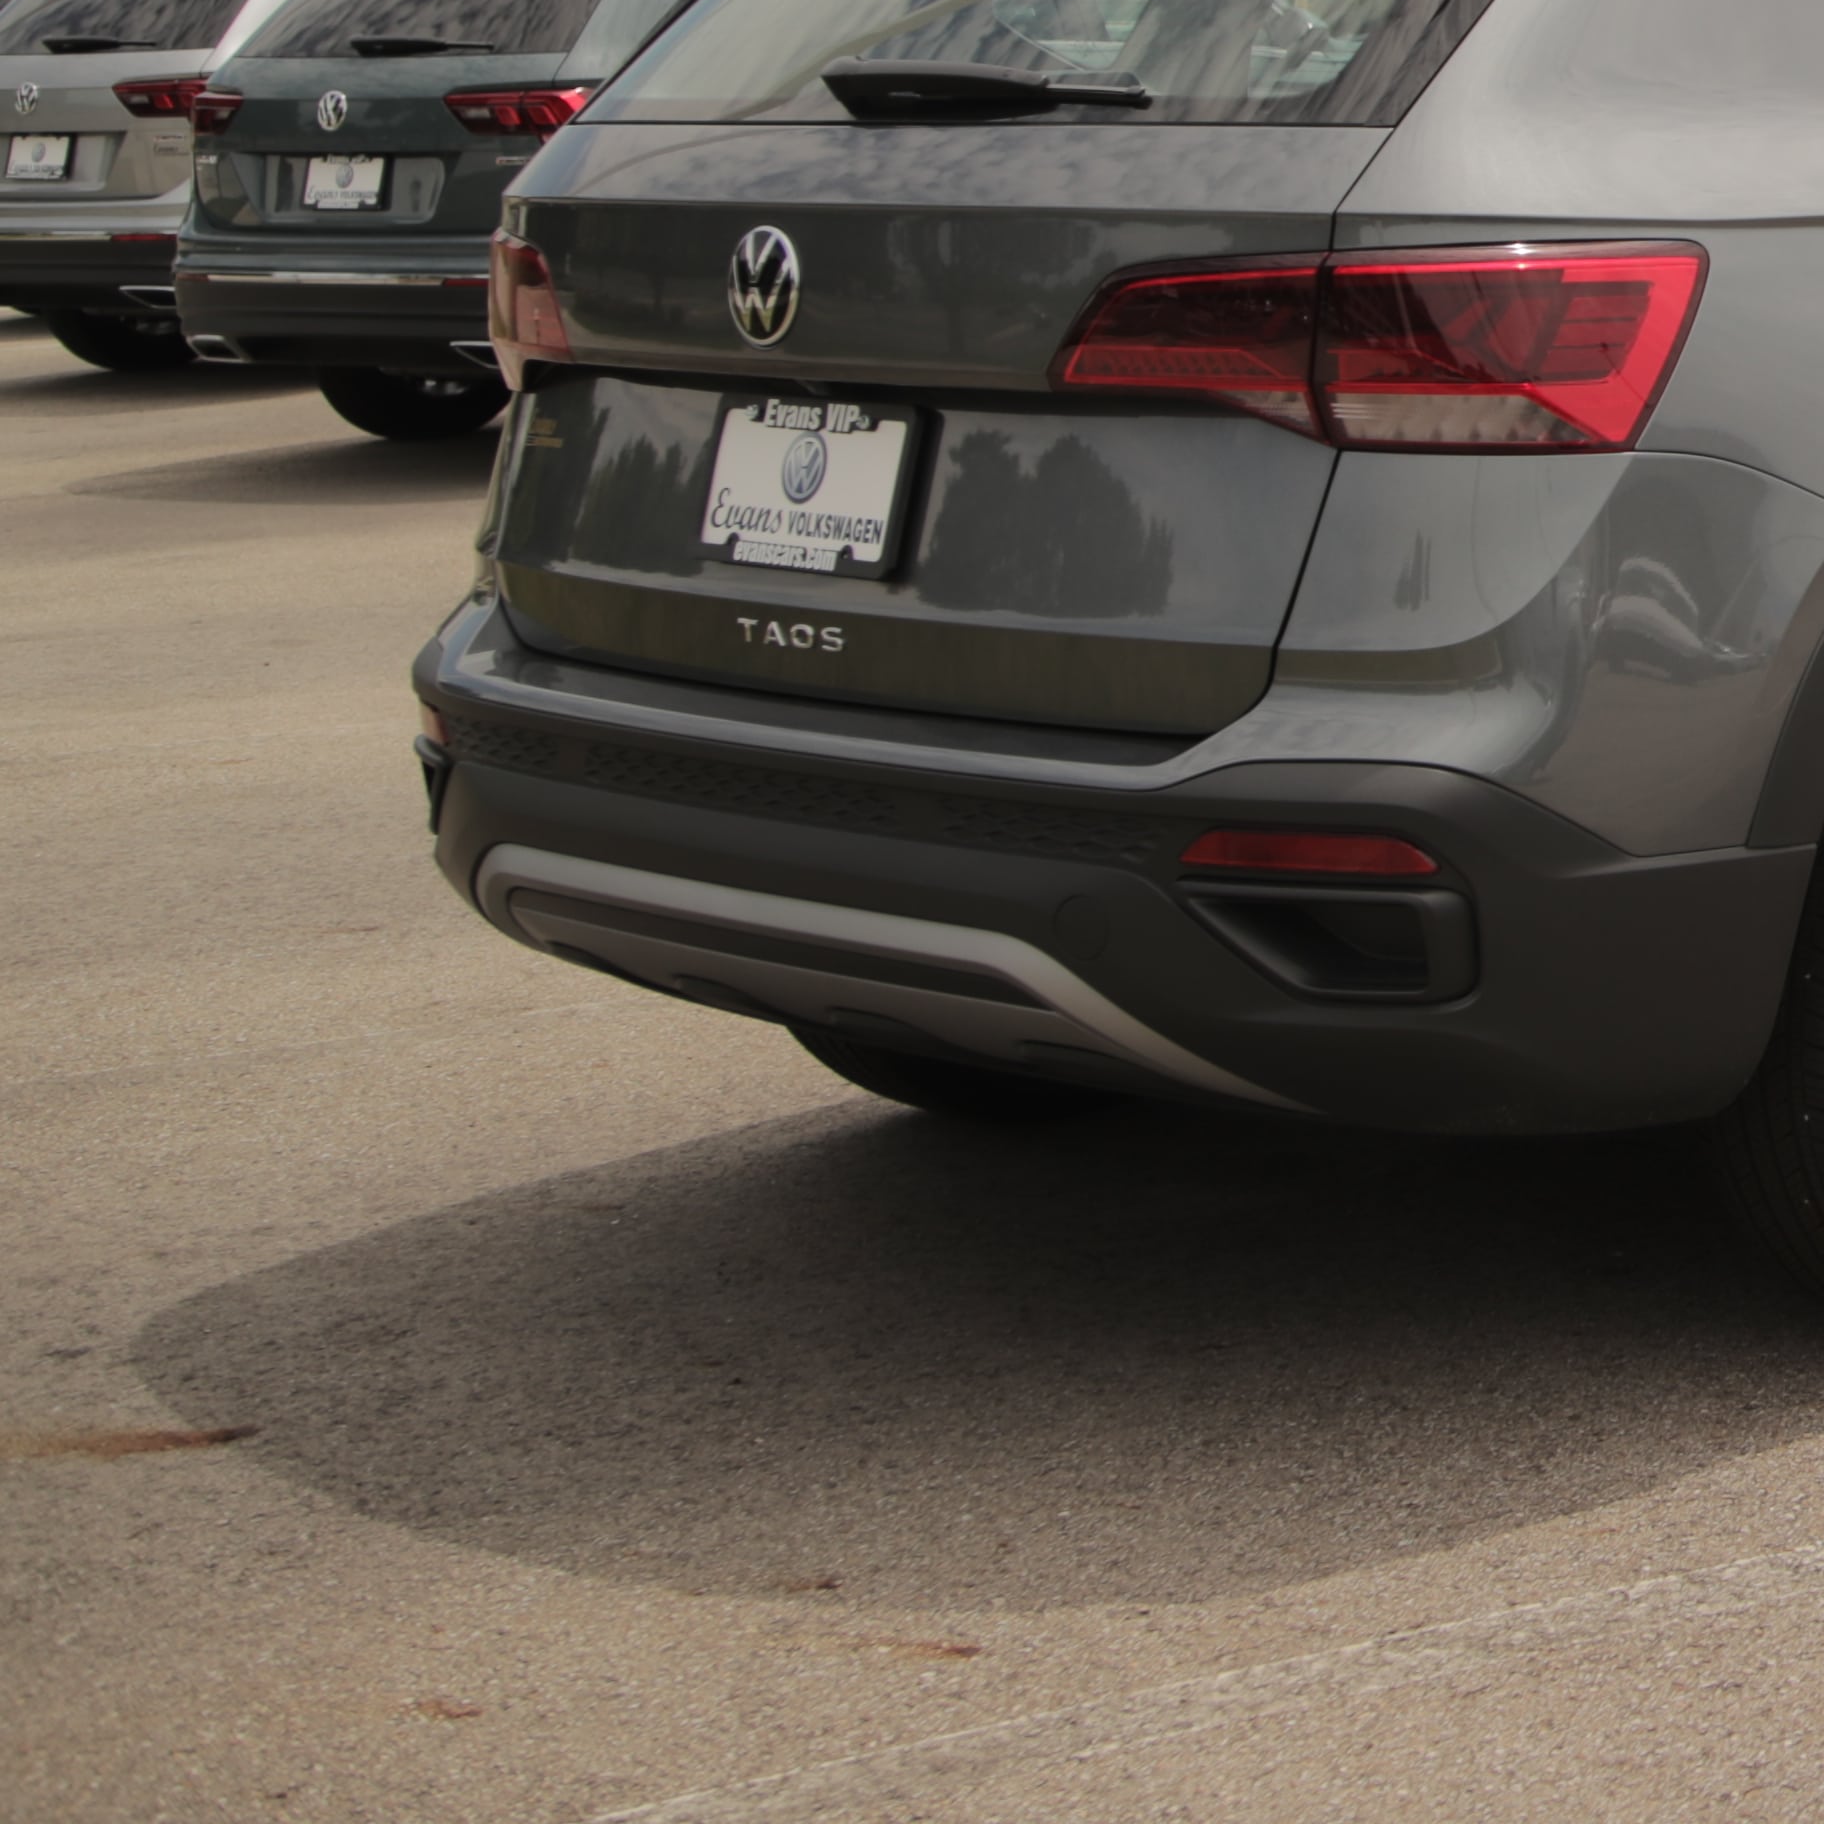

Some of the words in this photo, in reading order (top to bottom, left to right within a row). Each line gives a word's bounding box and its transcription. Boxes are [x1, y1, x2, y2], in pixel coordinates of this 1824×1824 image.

[729, 226, 799, 341] VW
[763, 398, 822, 431] Evans
[825, 403, 860, 433] VIP
[711, 488, 783, 534] Evans
[788, 510, 884, 544] VOLKSWAGEN
[733, 540, 838, 572] evanscars.com
[737, 617, 845, 652] TAOS
